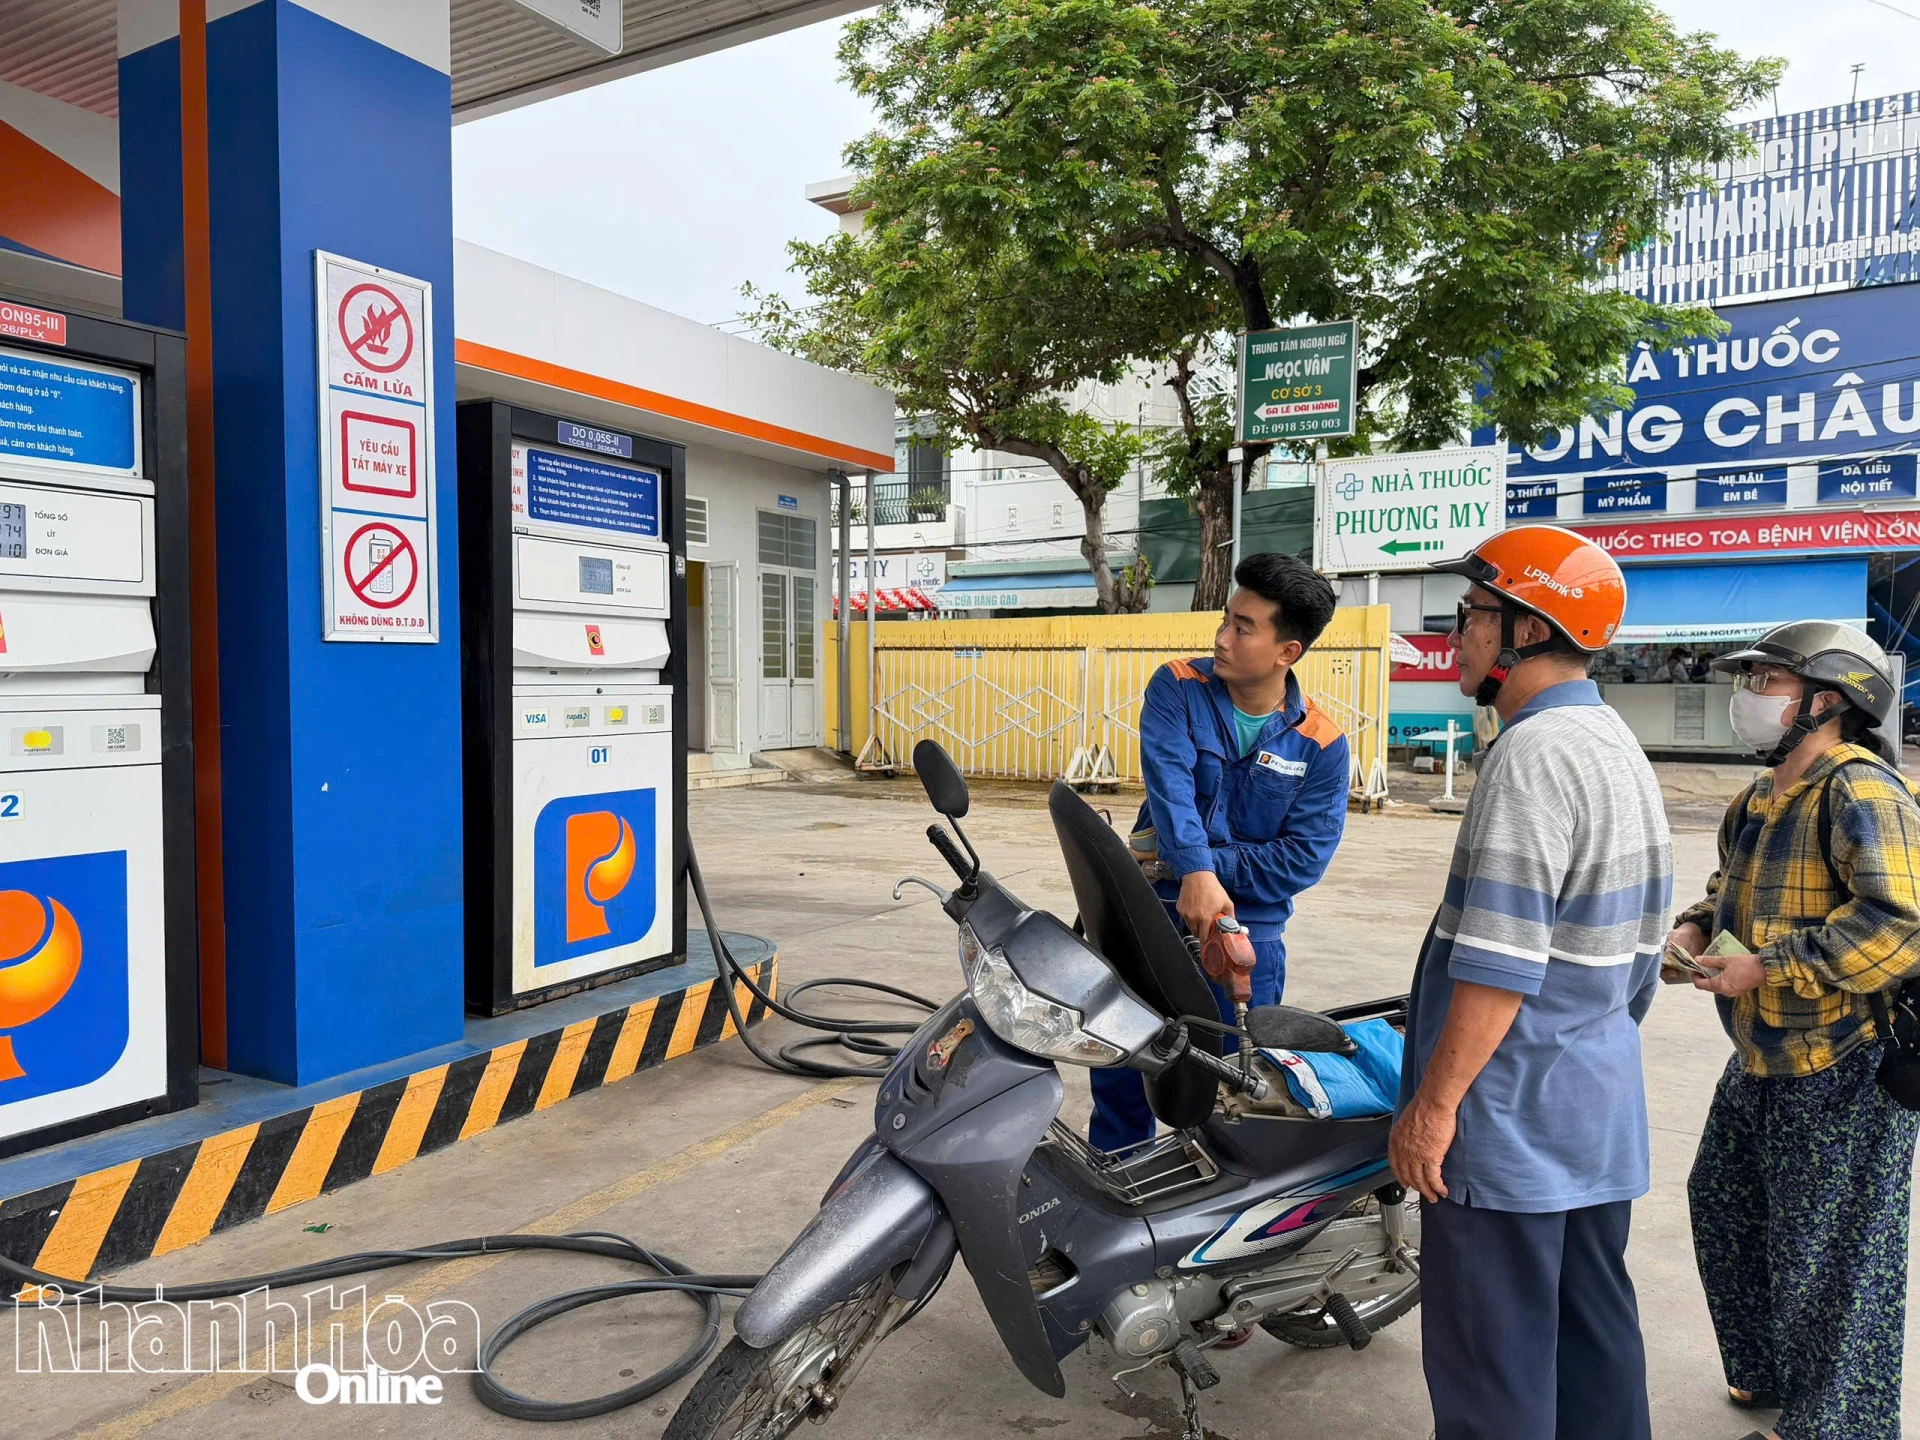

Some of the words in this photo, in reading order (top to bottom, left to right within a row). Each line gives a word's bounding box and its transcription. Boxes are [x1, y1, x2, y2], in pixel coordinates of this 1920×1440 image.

[1666, 185, 1834, 244] PHARMA
[0, 306, 59, 331] ON95-III
[0, 323, 45, 340] 26/PLX
[1251, 342, 1278, 355] TRUNG
[1300, 335, 1326, 351] NGOẠI
[1673, 317, 1840, 379] THUỐC
[1265, 360, 1301, 385] NGỌC
[1304, 353, 1330, 376] VÂN
[343, 371, 378, 390] CẤM
[384, 378, 413, 397] LỬA
[1271, 388, 1290, 400] CƠ
[1293, 383, 1312, 398] SỞ
[1315, 385, 1322, 396] 3
[1266, 407, 1278, 415] 6A
[1703, 373, 1920, 448] CHÂU
[572, 426, 586, 439] DO
[1252, 424, 1269, 435] ĐT:
[1272, 422, 1297, 433] 0918
[1299, 420, 1318, 431] 550
[1321, 419, 1341, 429] 003
[360, 439, 378, 454] YÊU
[380, 440, 400, 457] CẦU
[352, 454, 369, 471] TẮT
[373, 459, 393, 475] MÁY
[396, 464, 407, 476] XE
[1371, 469, 1414, 493] NHÀ
[1419, 459, 1492, 489] THUỐC
[1841, 481, 1865, 495] NỘI
[1868, 477, 1893, 492] TIẾT
[1617, 493, 1651, 507] PHẨM
[1723, 491, 1740, 501] EM
[34, 511, 56, 521] TỔNG
[58, 511, 68, 521] SỐ
[1335, 505, 1438, 535] PHƯƠNG
[1448, 501, 1490, 529] MY
[1650, 531, 1703, 549] THEO
[1709, 529, 1751, 546] TOA
[1758, 523, 1813, 547] BỆNH
[1820, 520, 1869, 544] VIỆN
[54, 548, 69, 557] GIÁ
[1523, 565, 1571, 597] LPBank
[974, 593, 997, 606] HÀNG
[339, 611, 369, 626] KHÔNG
[371, 613, 394, 627] DÙNG
[525, 714, 546, 723] VISA
[591, 748, 607, 763] 01
[1018, 1197, 1061, 1224] ONDA
